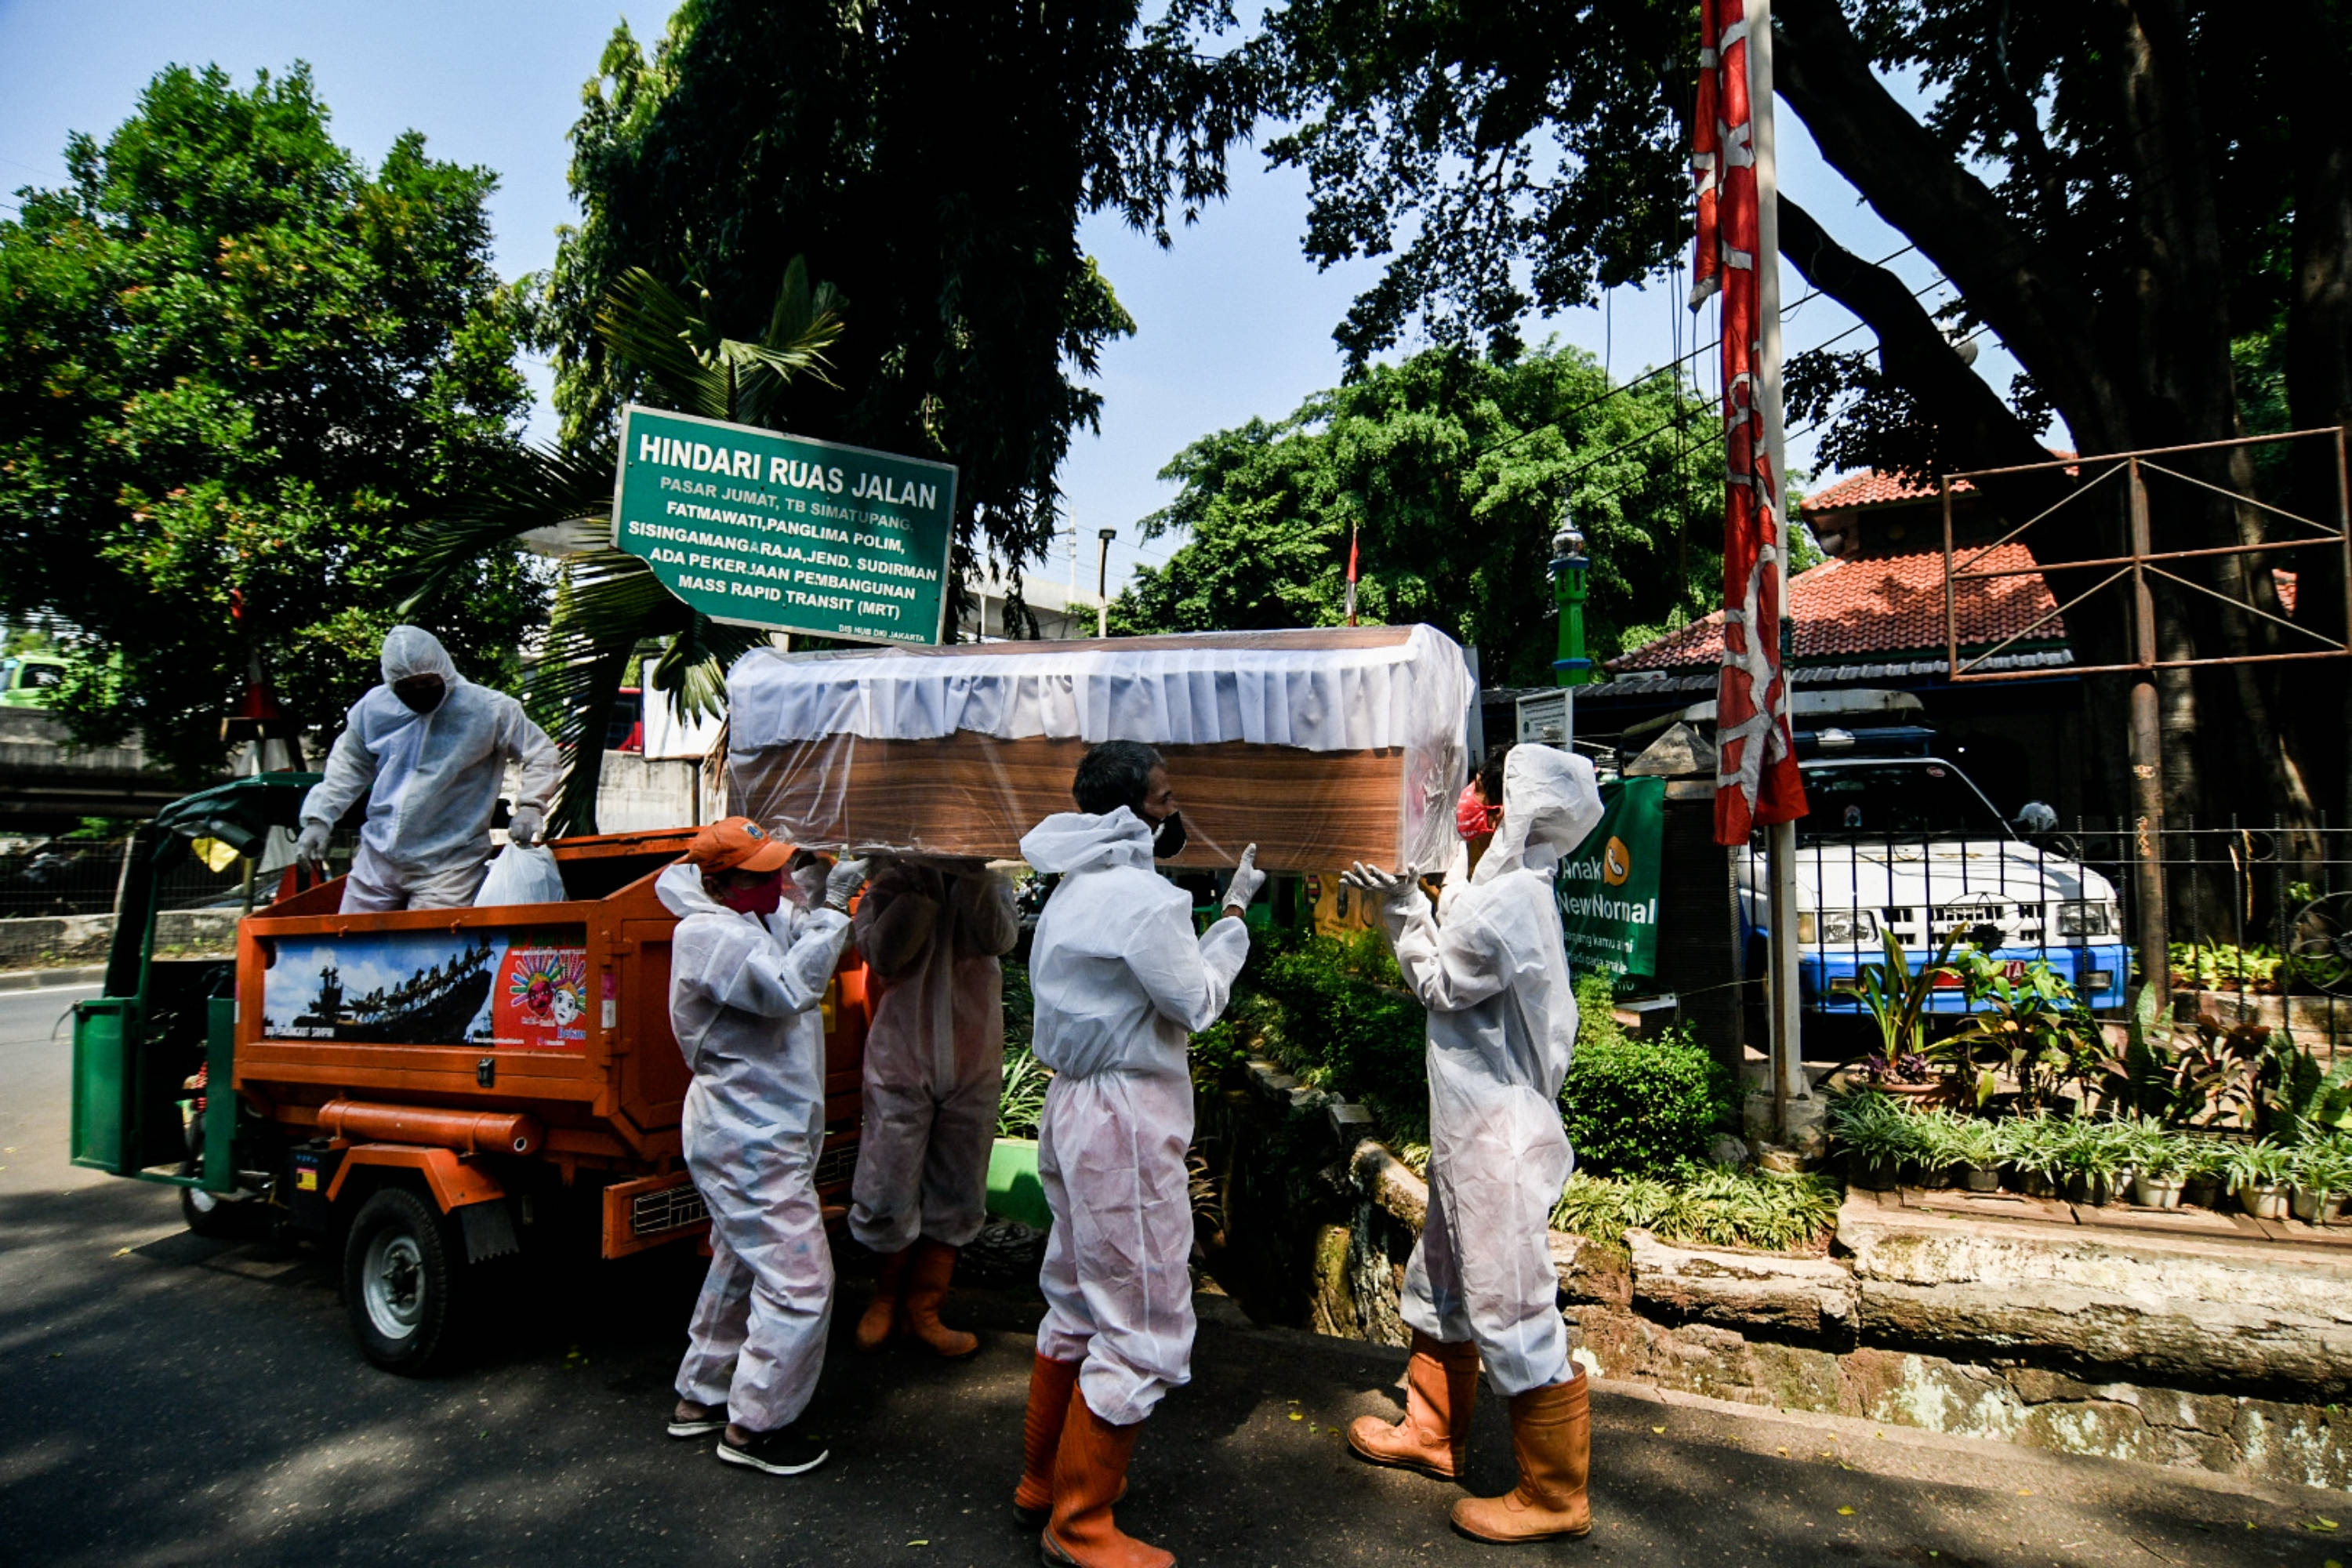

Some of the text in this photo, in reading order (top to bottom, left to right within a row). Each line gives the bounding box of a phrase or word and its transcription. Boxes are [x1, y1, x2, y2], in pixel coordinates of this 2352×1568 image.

[639, 434, 937, 510] HINDARI RUAS JALAN
[660, 476, 717, 499] PASAR
[721, 488, 779, 511] JUMAT,
[785, 498, 806, 513] TB
[853, 532, 906, 555] POLIM,
[649, 547, 916, 601] ADA PEKERJAAN PEMBANGUNAN
[857, 557, 937, 582] SUDIRMAN
[678, 575, 901, 620] MASS RAPID TRANSIT (MRT)
[838, 624, 852, 633] DIS
[873, 629, 887, 638] DKI
[888, 633, 925, 642] JAKARTA
[1561, 855, 1602, 880] Anak
